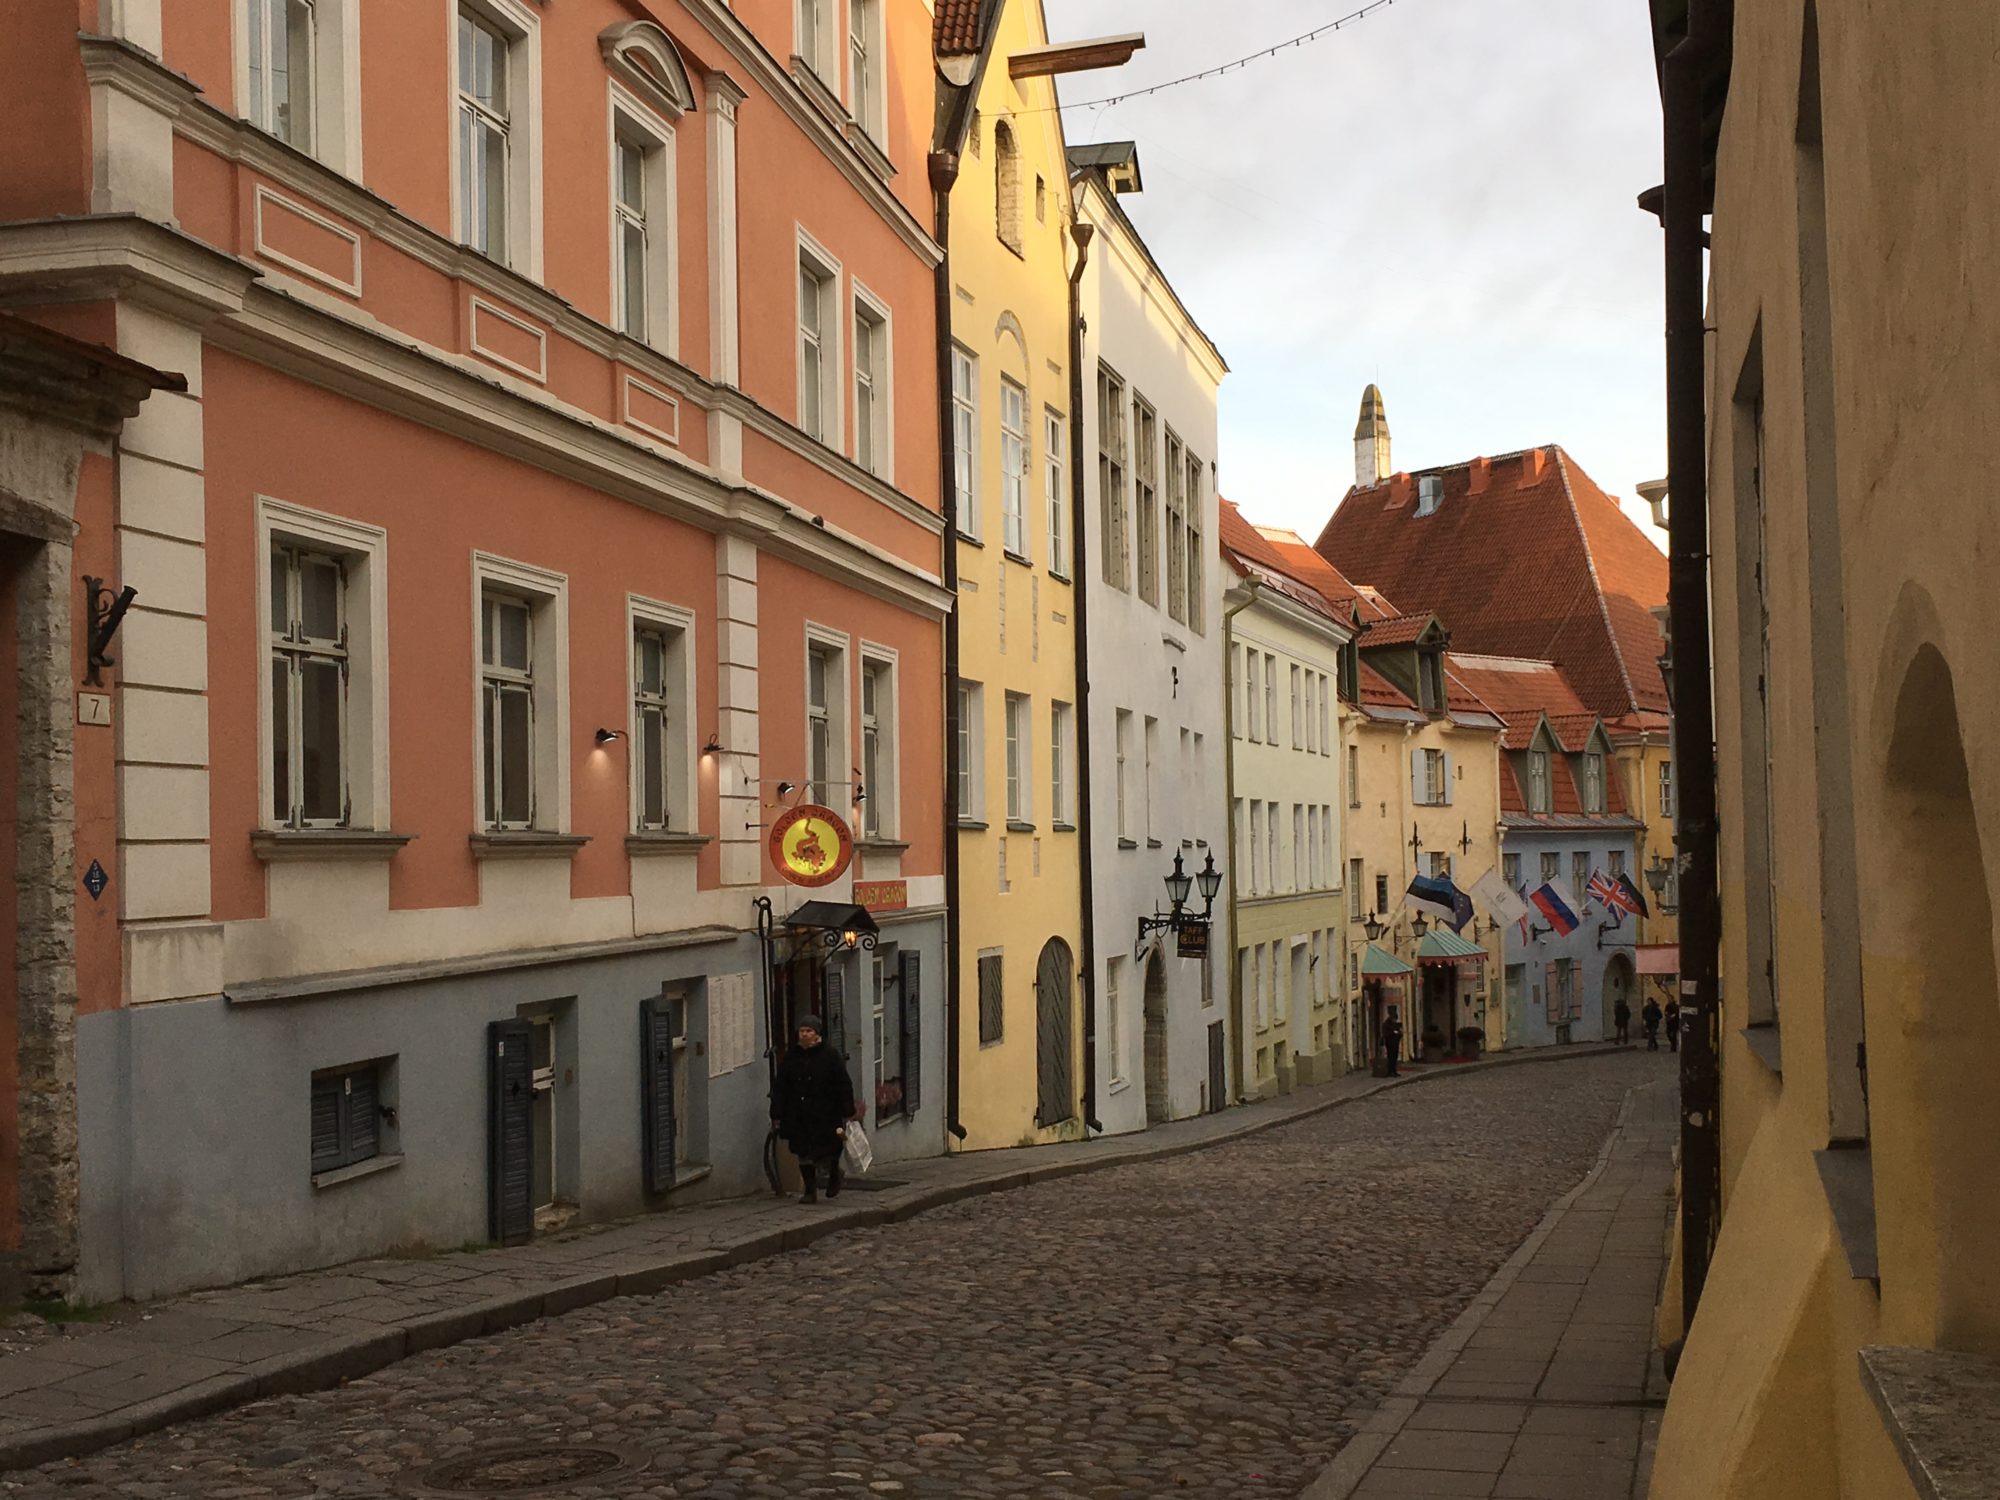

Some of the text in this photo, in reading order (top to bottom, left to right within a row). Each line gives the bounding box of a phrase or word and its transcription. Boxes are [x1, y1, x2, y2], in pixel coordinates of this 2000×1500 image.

[90, 698, 100, 719] 7
[773, 808, 849, 843] GOLDEN DRAGON
[855, 887, 879, 905] GOLDEN
[1180, 935, 1205, 944] CLUB
